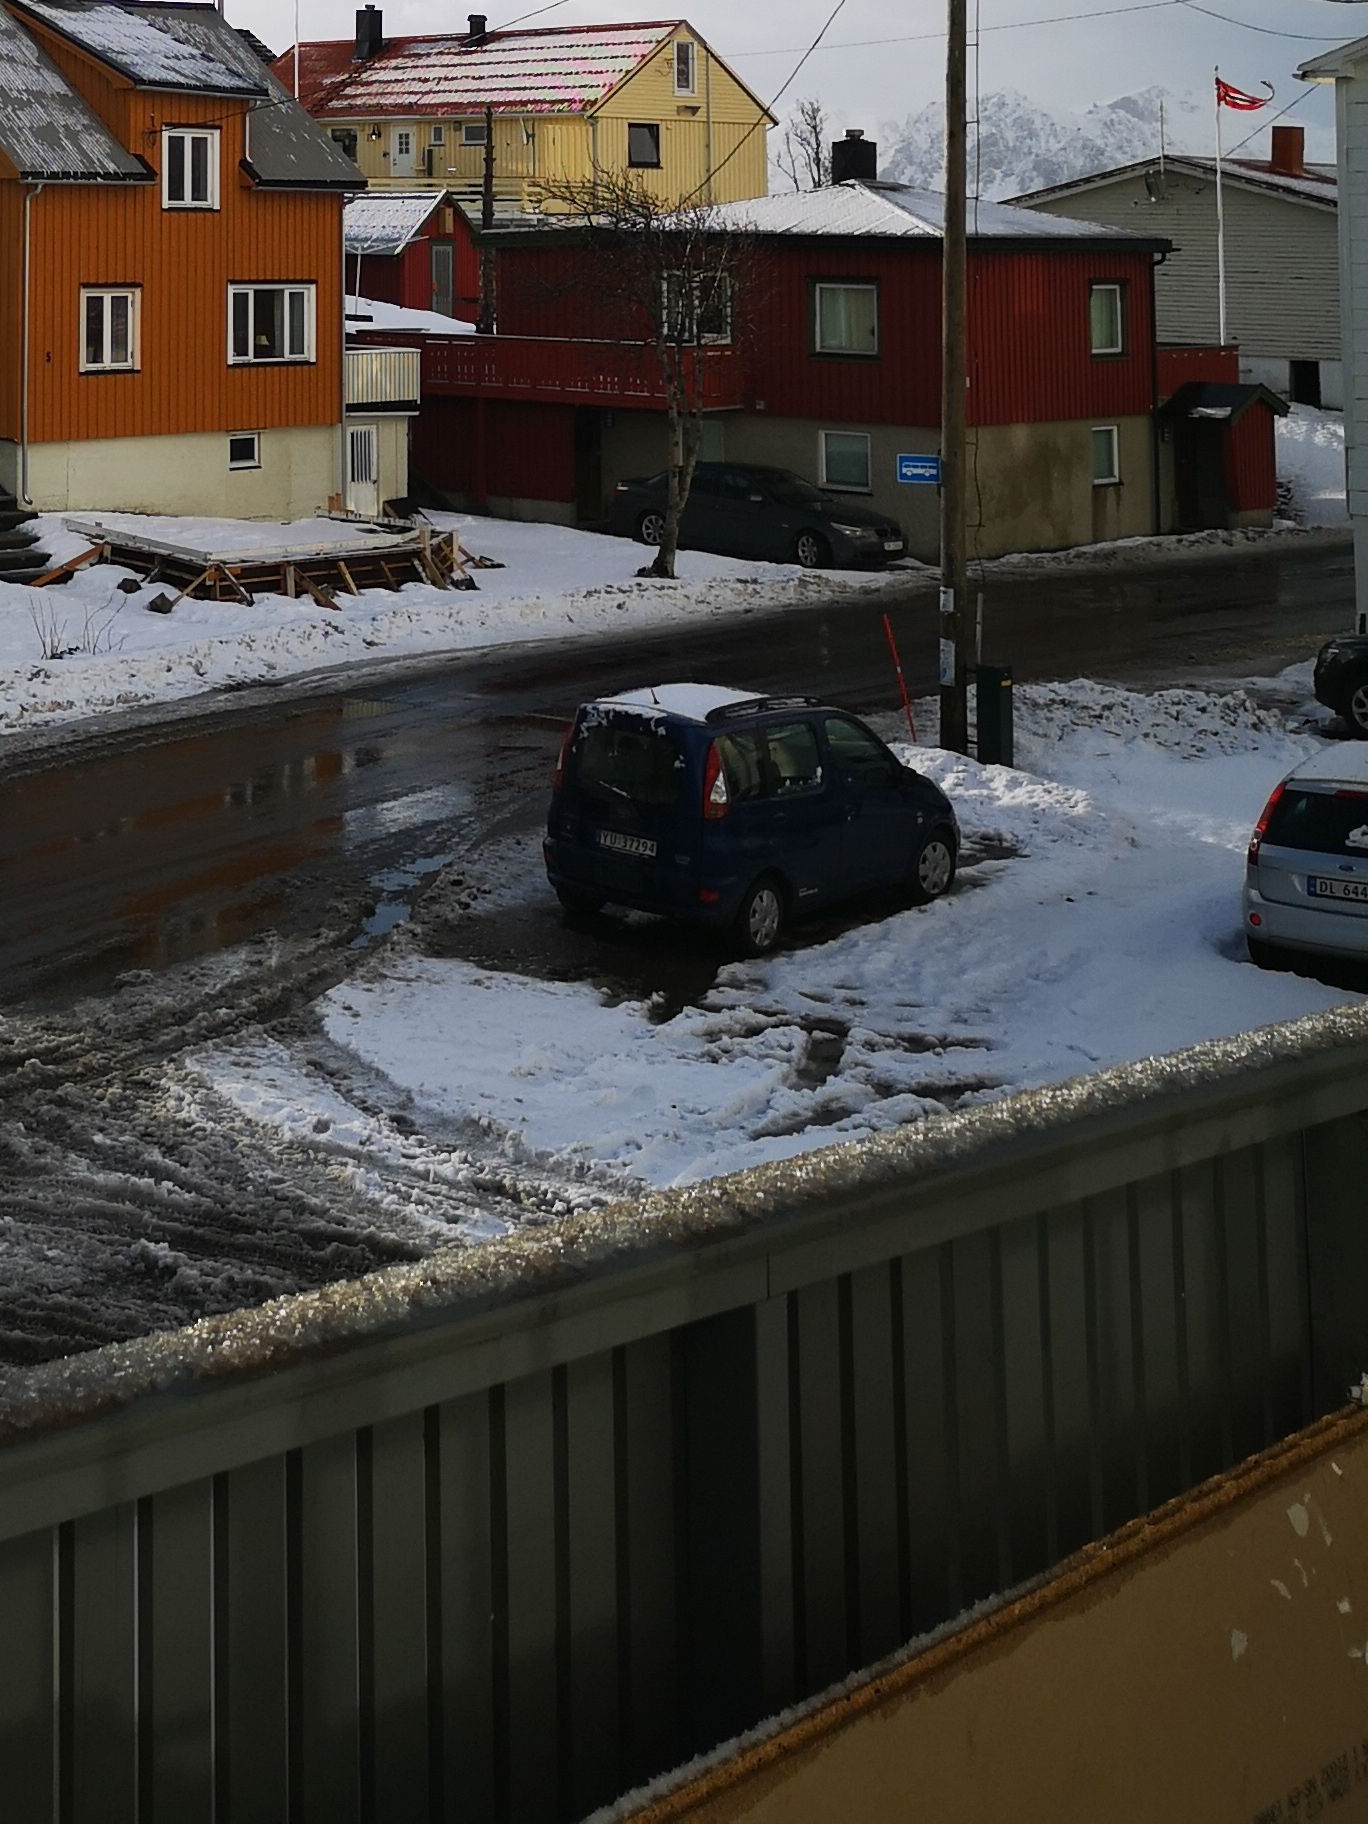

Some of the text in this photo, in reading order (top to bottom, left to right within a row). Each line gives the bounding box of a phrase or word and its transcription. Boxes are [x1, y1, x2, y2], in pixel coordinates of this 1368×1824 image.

[46, 351, 52, 363] 5
[603, 831, 655, 854] YU 37294
[1319, 881, 1336, 895] DL
